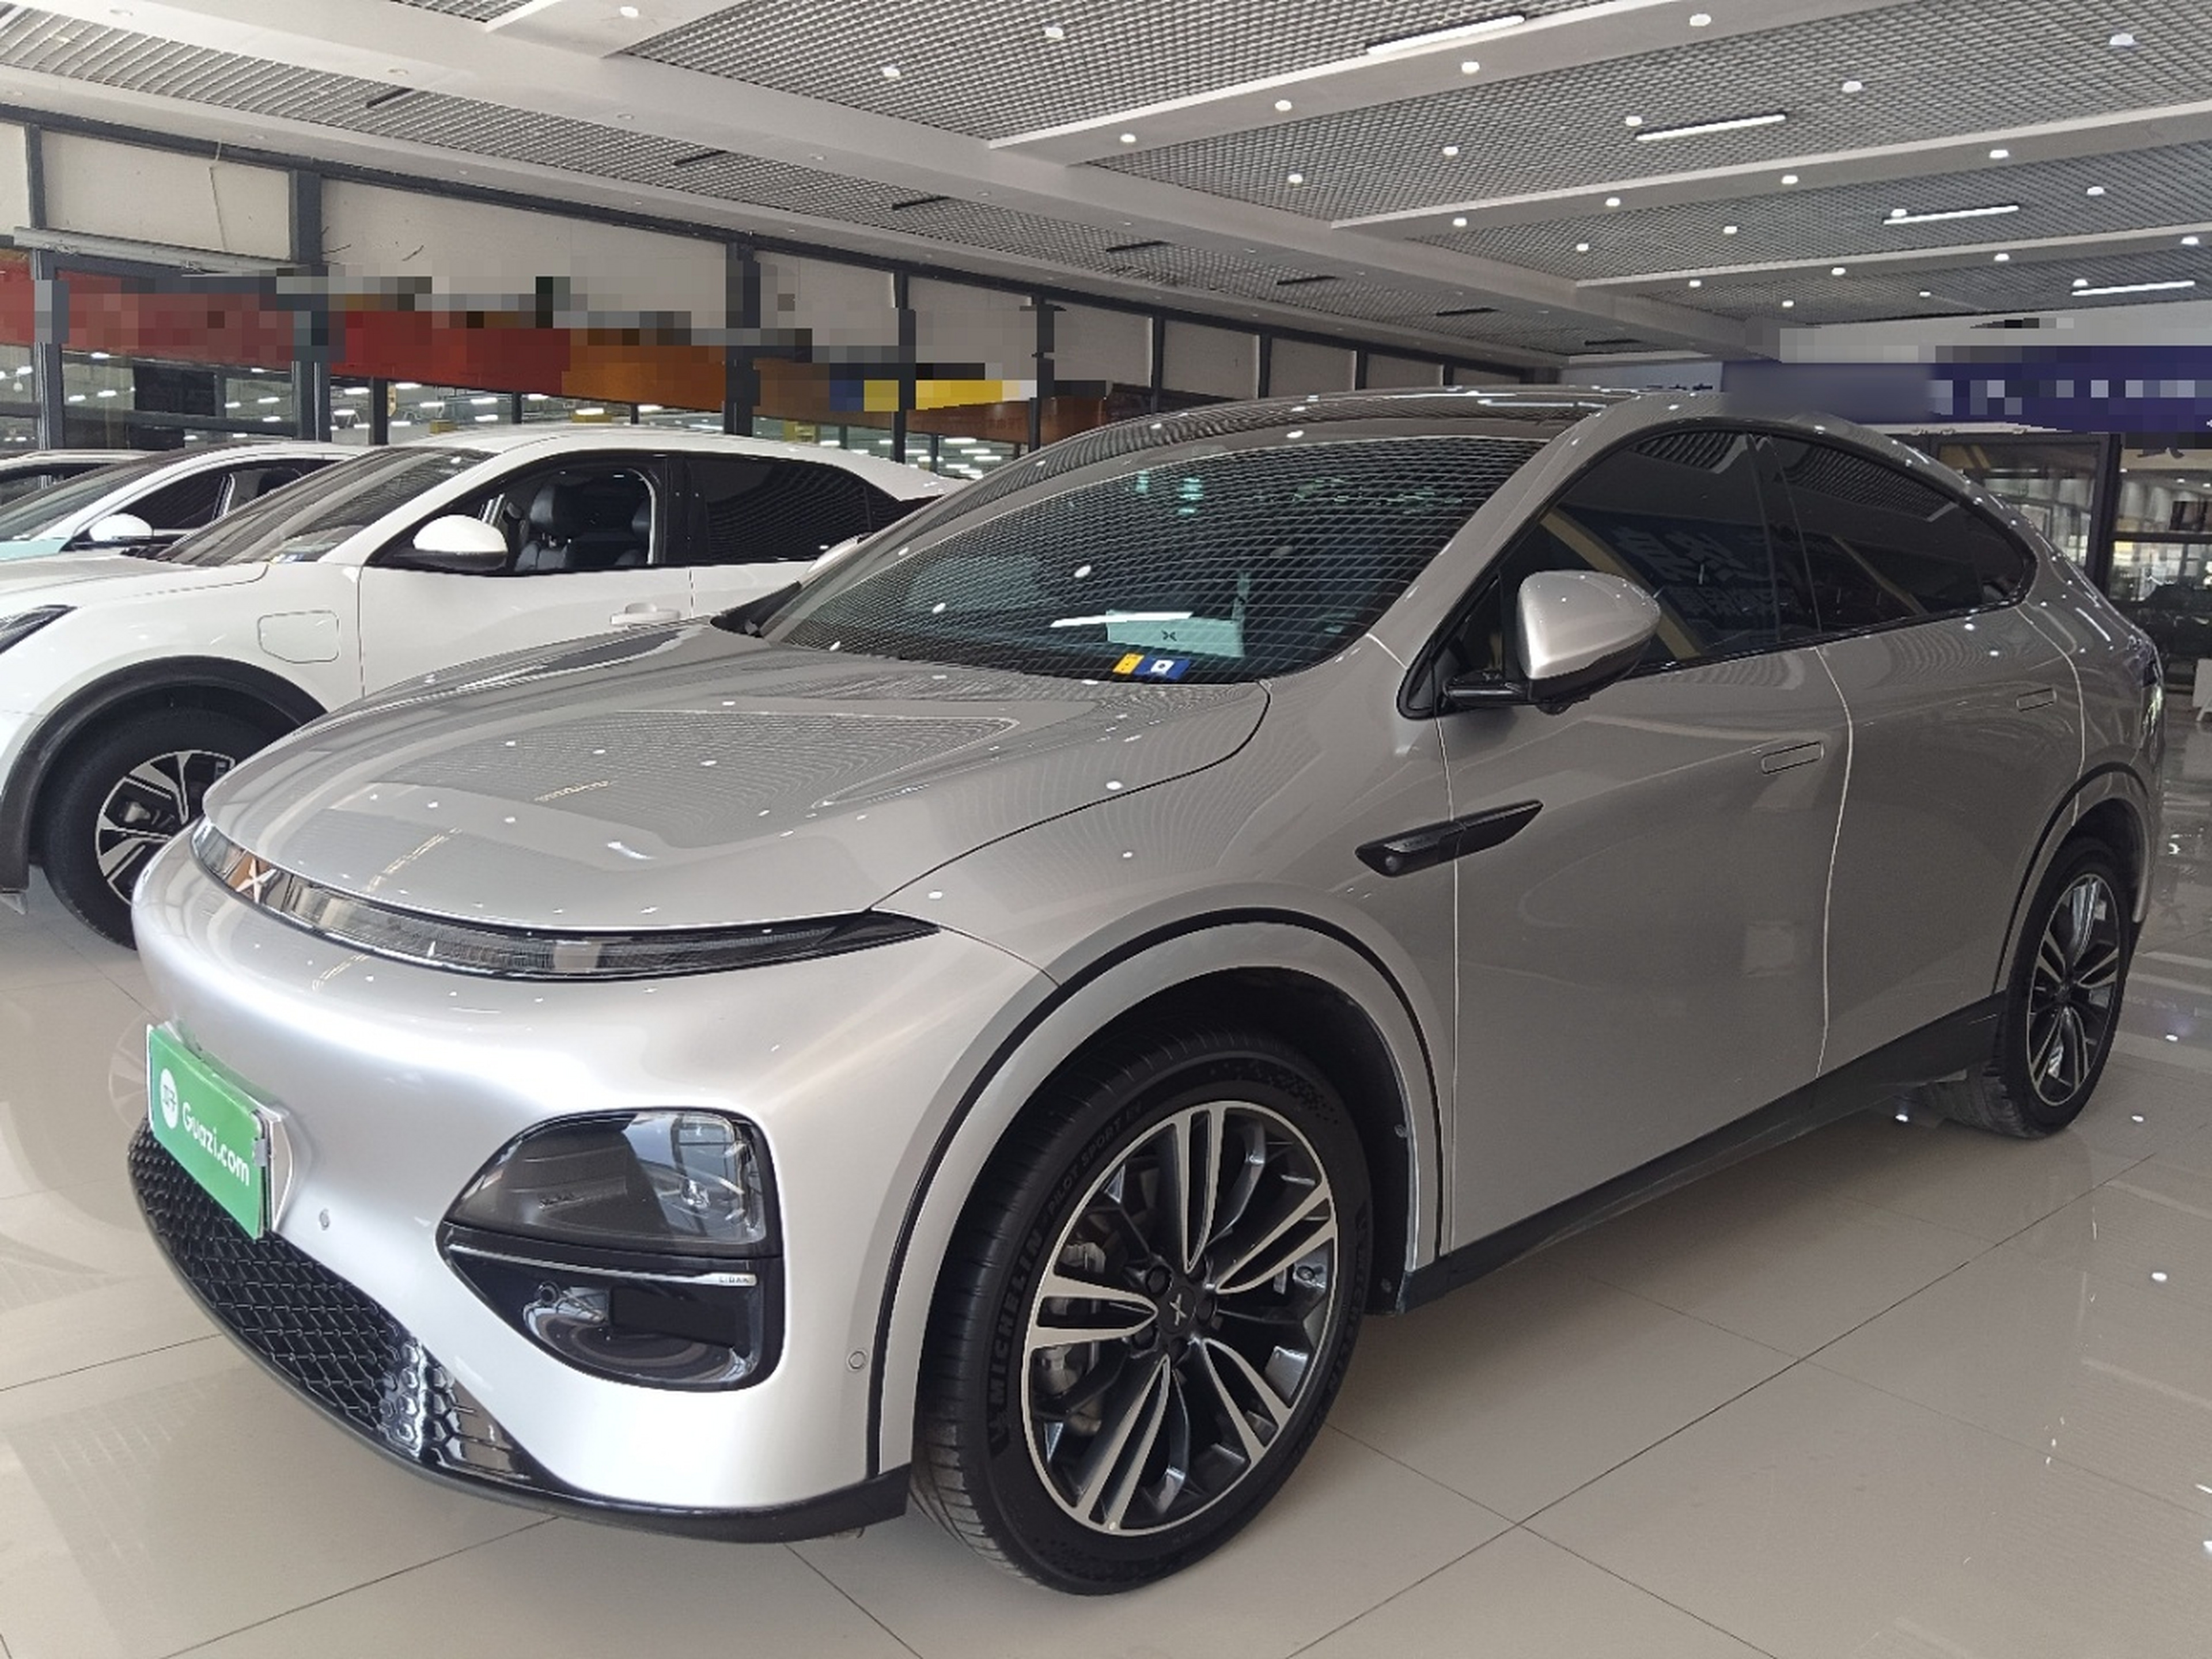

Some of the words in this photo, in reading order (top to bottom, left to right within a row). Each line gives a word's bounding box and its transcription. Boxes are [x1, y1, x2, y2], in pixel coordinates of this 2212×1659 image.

[183, 1101, 249, 1187] Guazi.com
[989, 1228, 1043, 1405] MICHELIN
[1048, 1164, 1080, 1216] PILOT
[1081, 1116, 1122, 1169] SPORT
